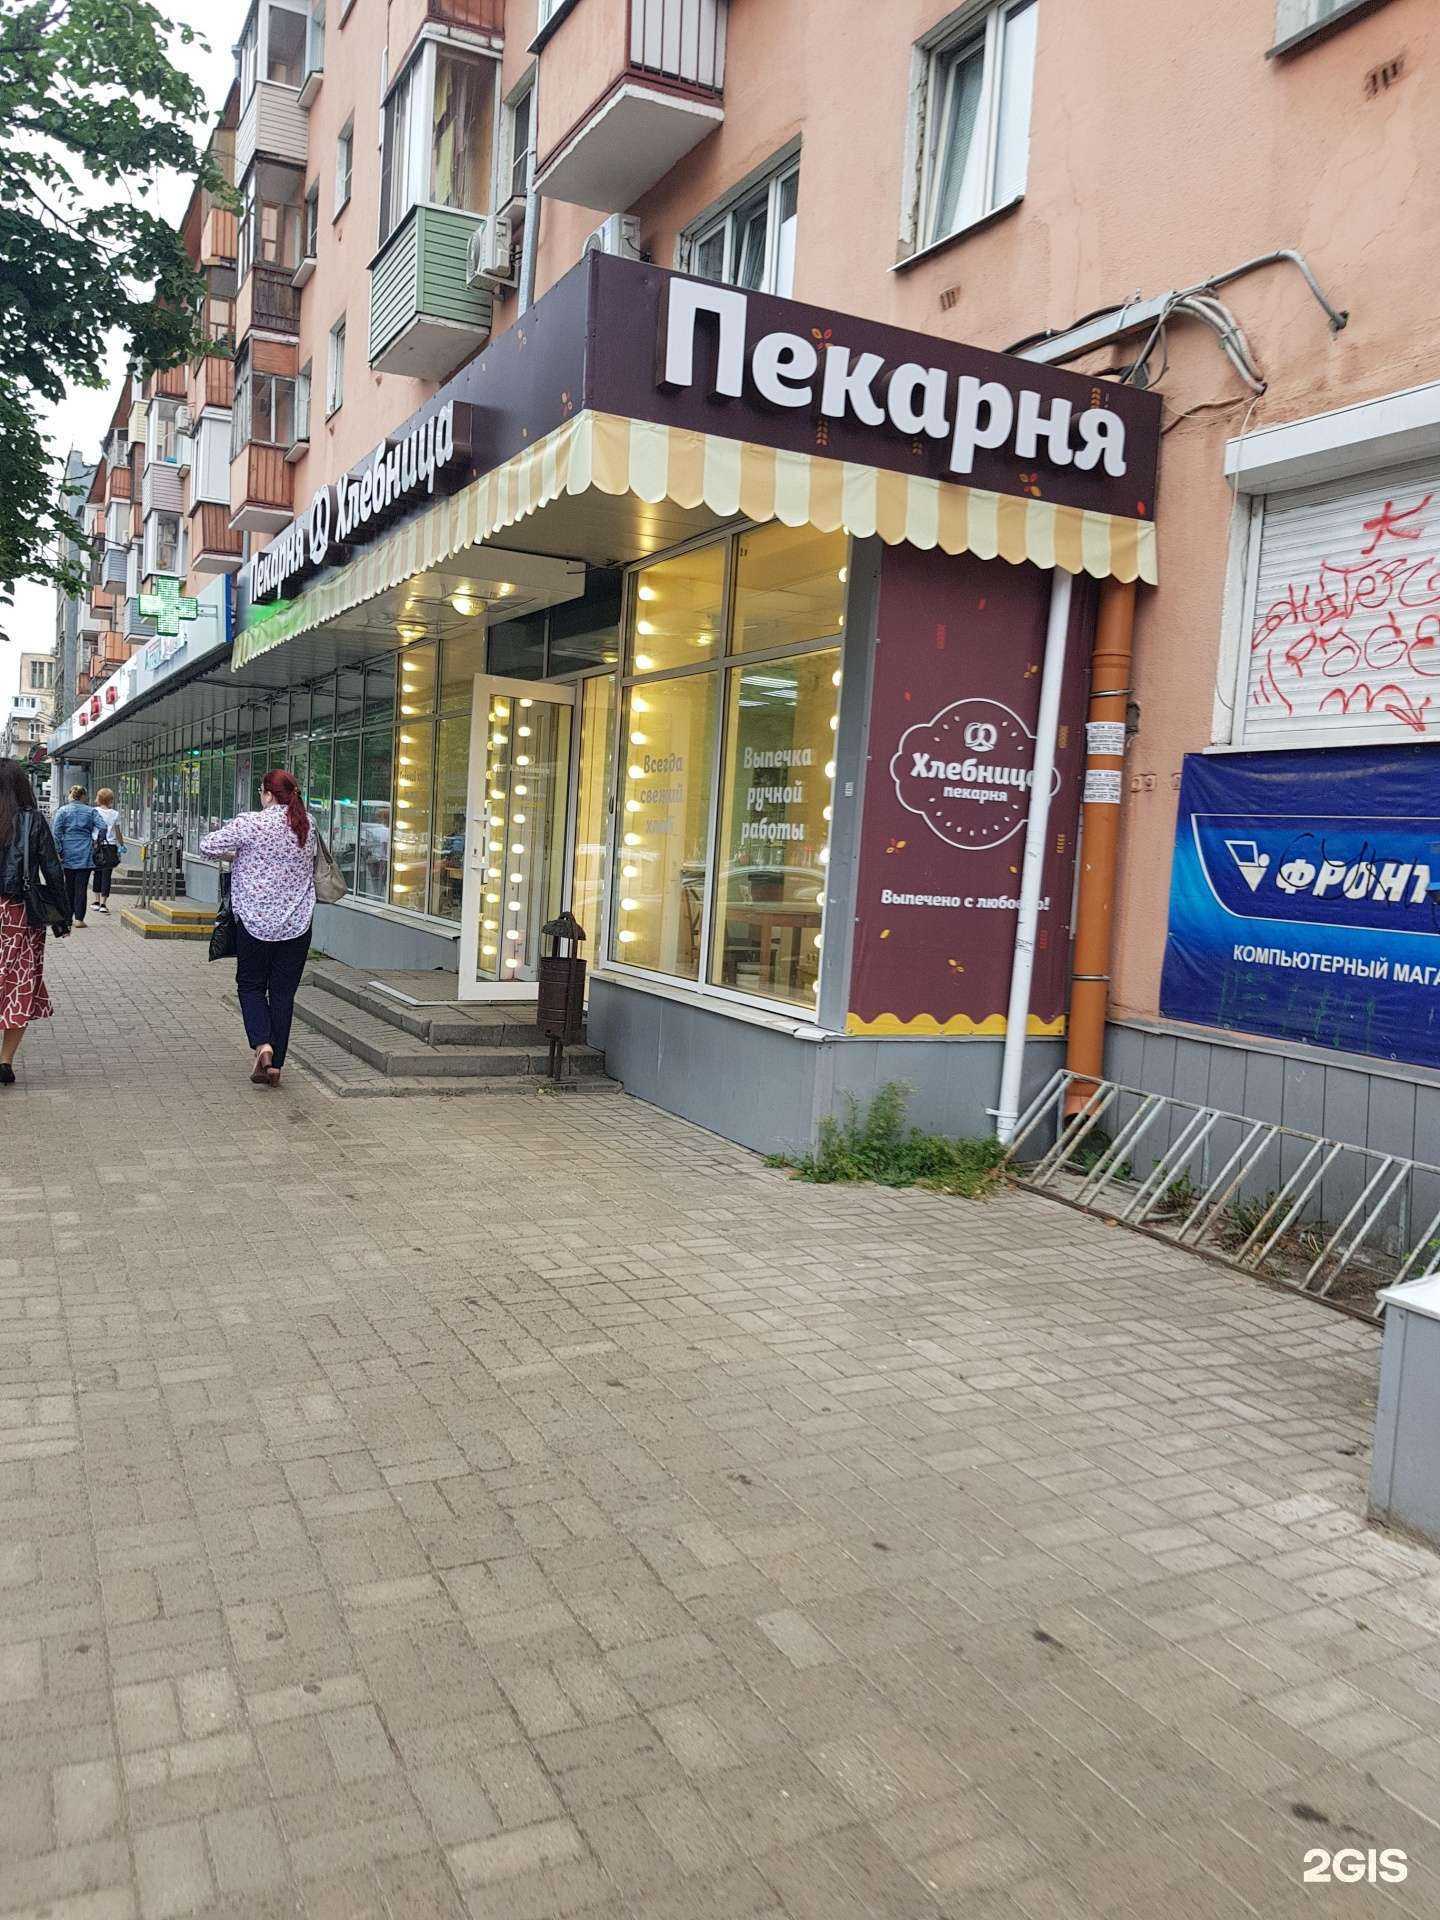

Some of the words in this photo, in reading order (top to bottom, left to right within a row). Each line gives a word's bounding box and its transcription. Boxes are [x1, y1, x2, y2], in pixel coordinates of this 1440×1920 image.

[664, 276, 1128, 478] Пекарня
[250, 527, 304, 603] Пекарня
[335, 399, 454, 543] Хлебница
[643, 753, 683, 774] Всегда
[744, 747, 812, 769] Выпечка
[747, 780, 803, 810] ручной
[943, 786, 1008, 804] пекарня
[741, 817, 804, 845] работы
[881, 889, 961, 908] Выпечено
[963, 896, 974, 909] с
[976, 895, 1050, 911] любов!
[1233, 944, 1389, 980] КОМПЬЮТЕРНЫЙ
